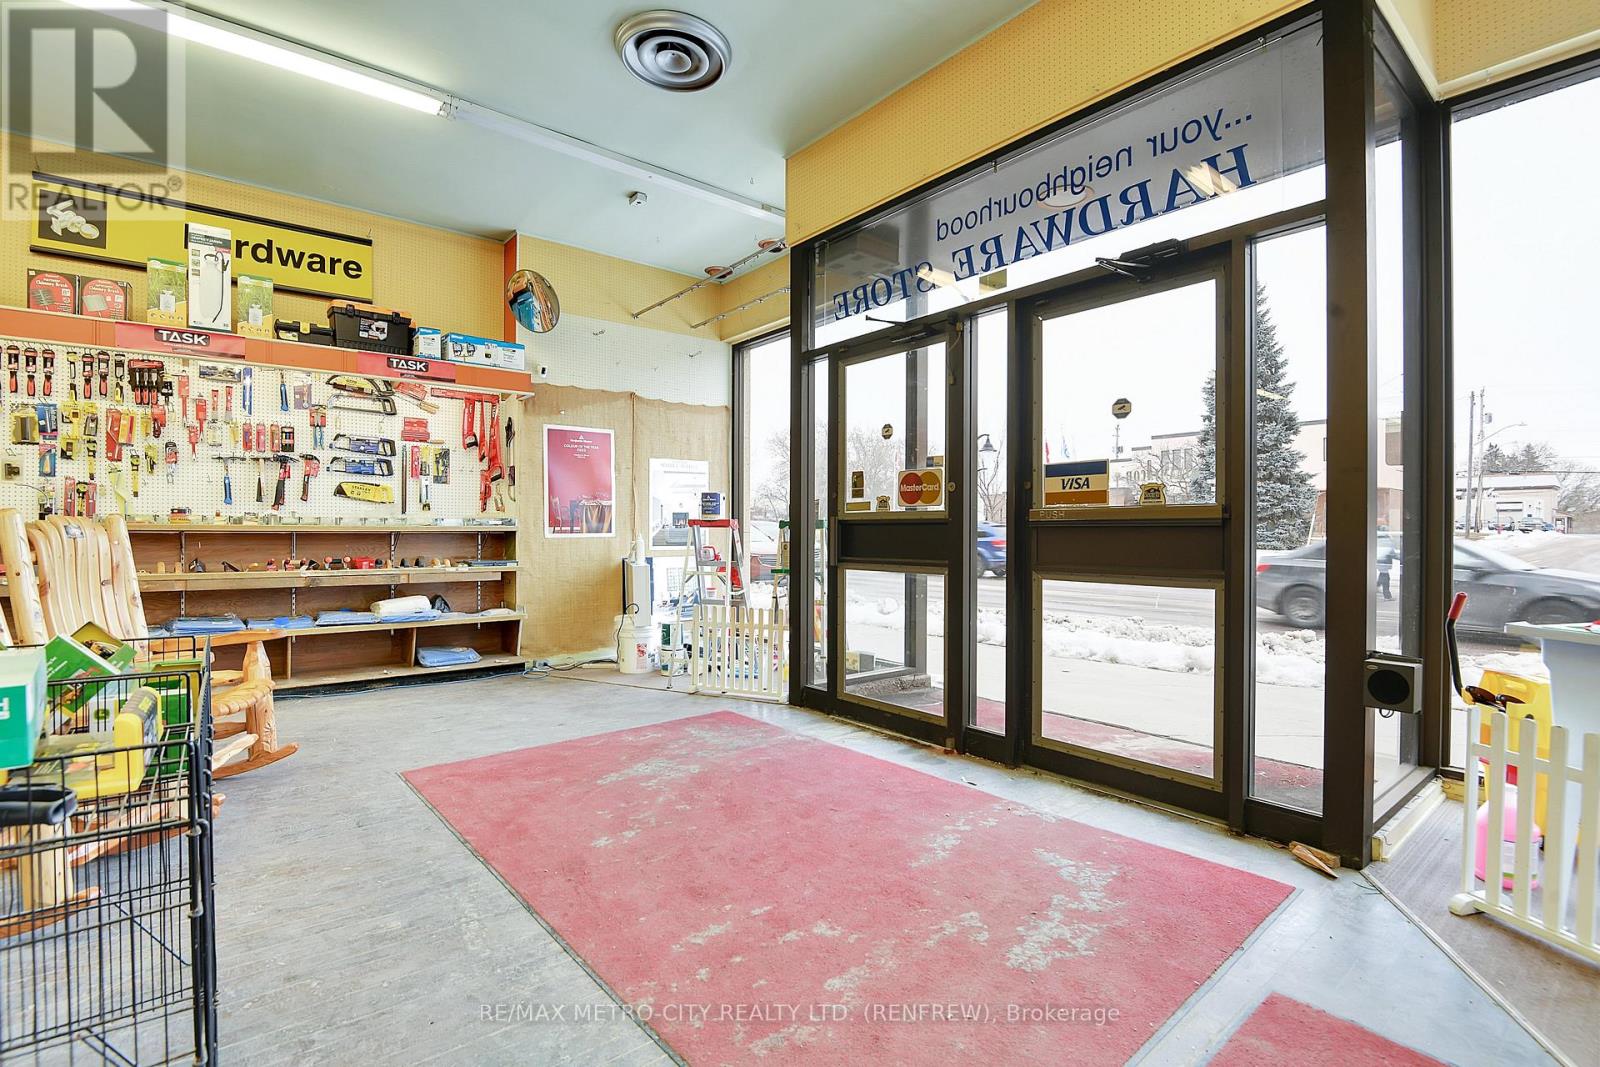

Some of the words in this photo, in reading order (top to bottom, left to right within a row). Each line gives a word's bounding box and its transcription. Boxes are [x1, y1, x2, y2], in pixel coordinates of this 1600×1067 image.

[158, 329, 207, 346] TASK
[389, 358, 427, 372] TASK
[901, 482, 940, 493] MasterCard
[1060, 477, 1091, 490] VISA
[1039, 510, 1065, 519] PUSH
